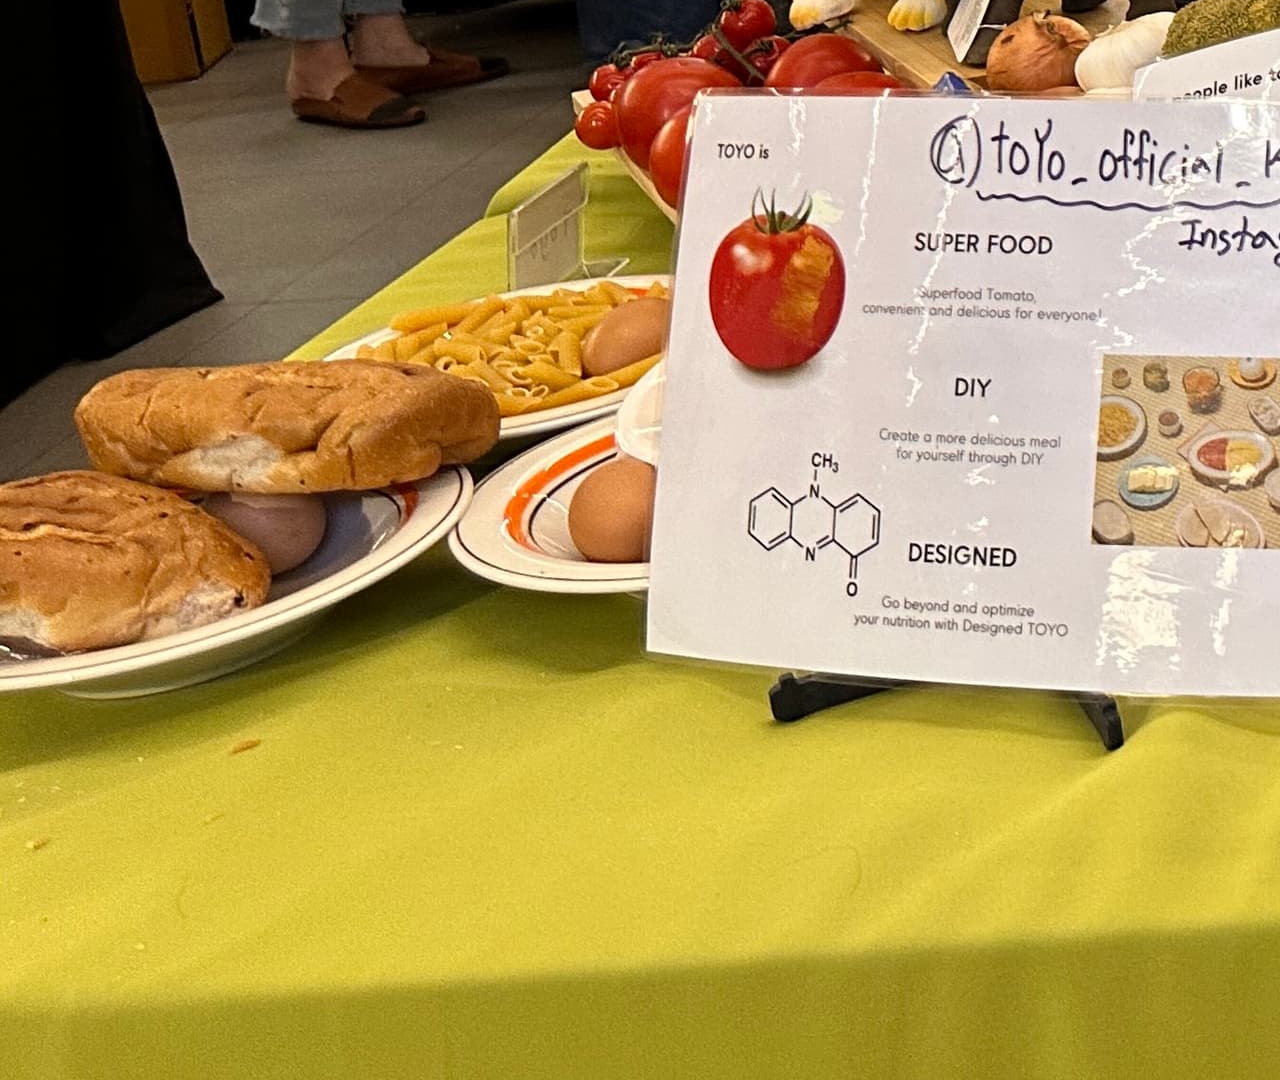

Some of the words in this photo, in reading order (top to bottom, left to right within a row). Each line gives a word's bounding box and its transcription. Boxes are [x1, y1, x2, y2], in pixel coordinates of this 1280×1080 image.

[1234, 74, 1262, 91] like
[718, 144, 755, 159] TOYO
[759, 145, 769, 159] is
[914, 233, 979, 253] SUPER
[988, 235, 1052, 254] FOOD
[919, 288, 982, 301] Superfood
[862, 305, 925, 315] convenient
[929, 305, 952, 316] and
[957, 306, 1010, 318] delicious
[1015, 307, 1033, 319] for
[955, 378, 991, 397] DIY
[879, 428, 919, 442] Create
[924, 434, 931, 443] a
[936, 434, 966, 444] more
[970, 433, 1025, 447] delicious
[1030, 436, 1061, 448] meal
[896, 446, 913, 459] for
[916, 450, 965, 462] yourself
[969, 451, 1016, 467] through
[1022, 452, 1044, 465] DIY
[809, 484, 820, 498] N
[805, 547, 816, 562] N
[909, 543, 1016, 567] DESIGNED
[847, 582, 858, 597] O
[882, 595, 900, 609] Go
[904, 598, 949, 613] beyond
[953, 602, 977, 614] and
[982, 605, 1034, 618] optimize
[854, 615, 879, 626] your
[883, 616, 930, 628] nutrition
[935, 619, 958, 630] with
[963, 619, 1023, 637] Designed
[1028, 622, 1068, 637] TOYO
